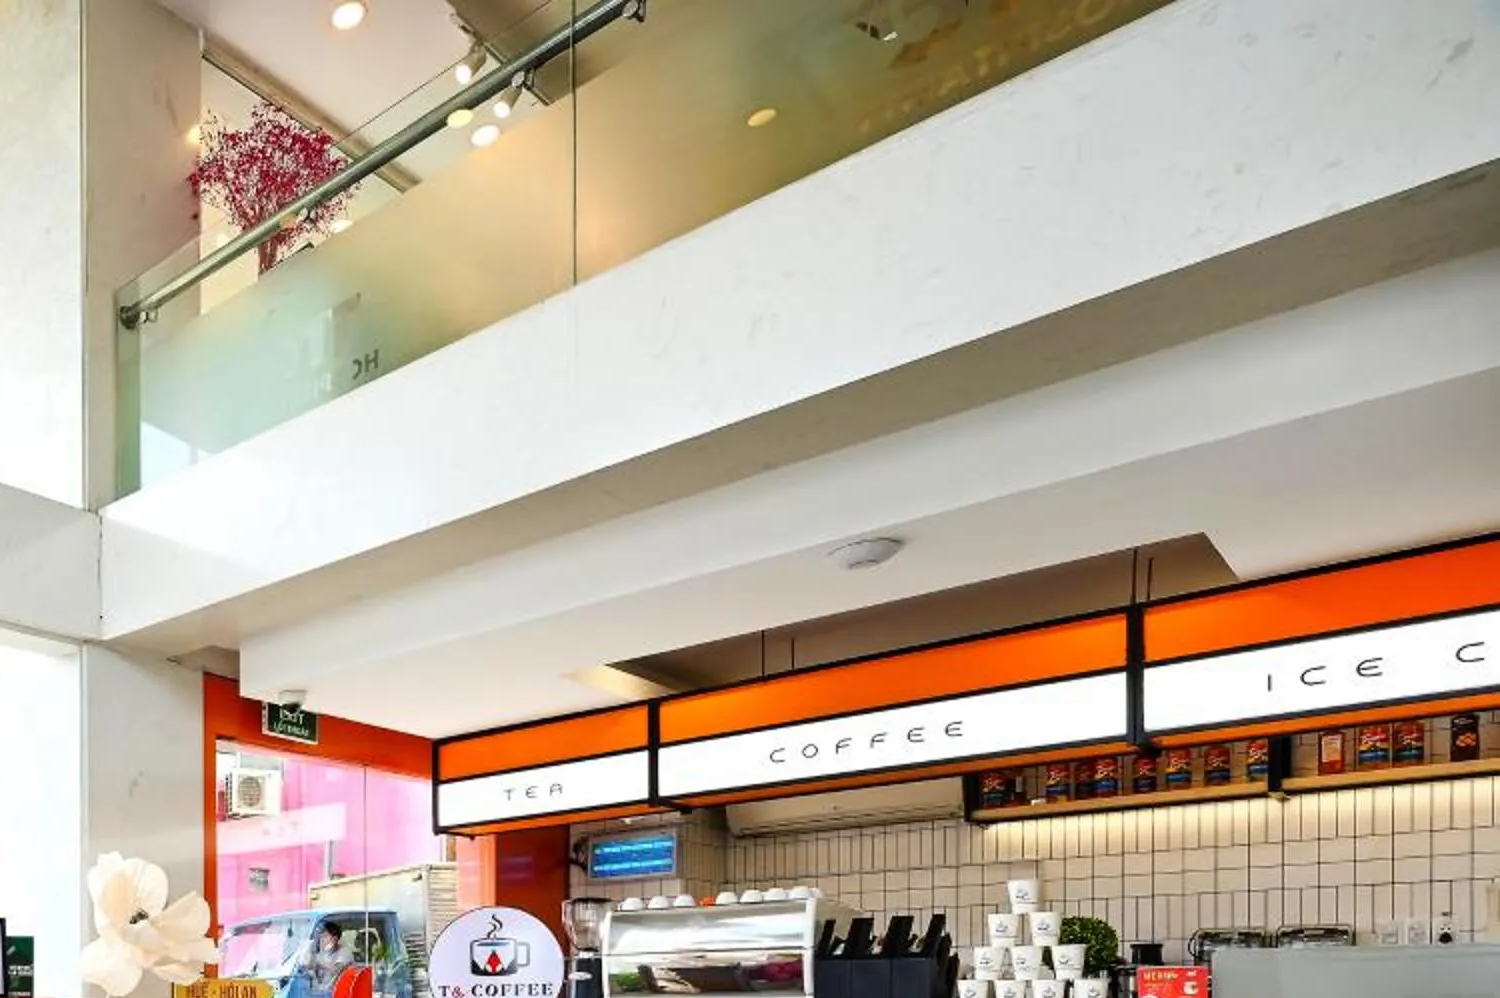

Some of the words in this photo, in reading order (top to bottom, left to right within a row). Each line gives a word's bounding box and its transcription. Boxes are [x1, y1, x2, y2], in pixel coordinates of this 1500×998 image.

[1266, 656, 1384, 693] ICE
[769, 721, 963, 763] COFFEE
[503, 783, 563, 801] TEA
[438, 985, 465, 998] T&
[471, 983, 553, 997] COFFEE
